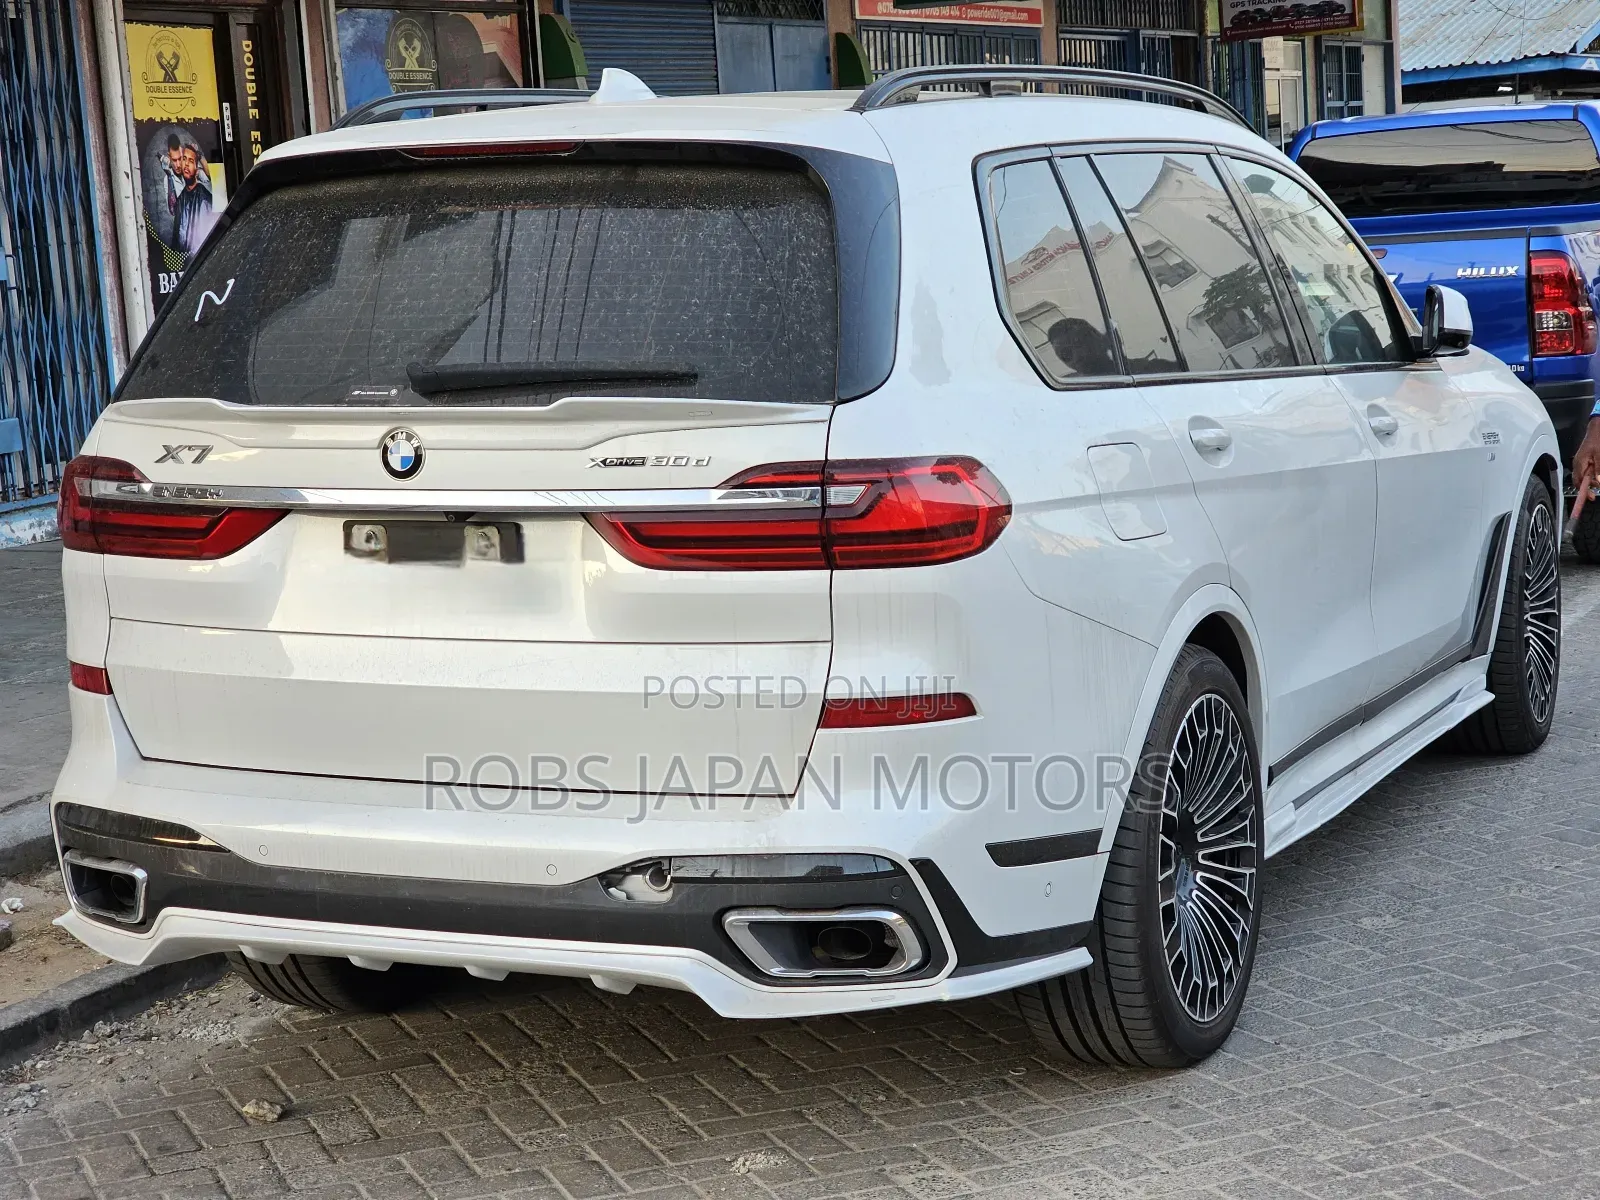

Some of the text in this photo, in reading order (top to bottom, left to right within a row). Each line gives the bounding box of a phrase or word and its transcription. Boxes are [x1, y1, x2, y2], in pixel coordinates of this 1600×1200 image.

[242, 40, 259, 119] DOUBLE
[388, 72, 432, 80] DOUBLE ESSENCE
[145, 85, 192, 94] DOUBLE ESSENCE
[223, 106, 232, 138] PUSH
[1457, 265, 1519, 277] HILUX
[385, 432, 421, 448] BMW
[154, 444, 214, 464] X7
